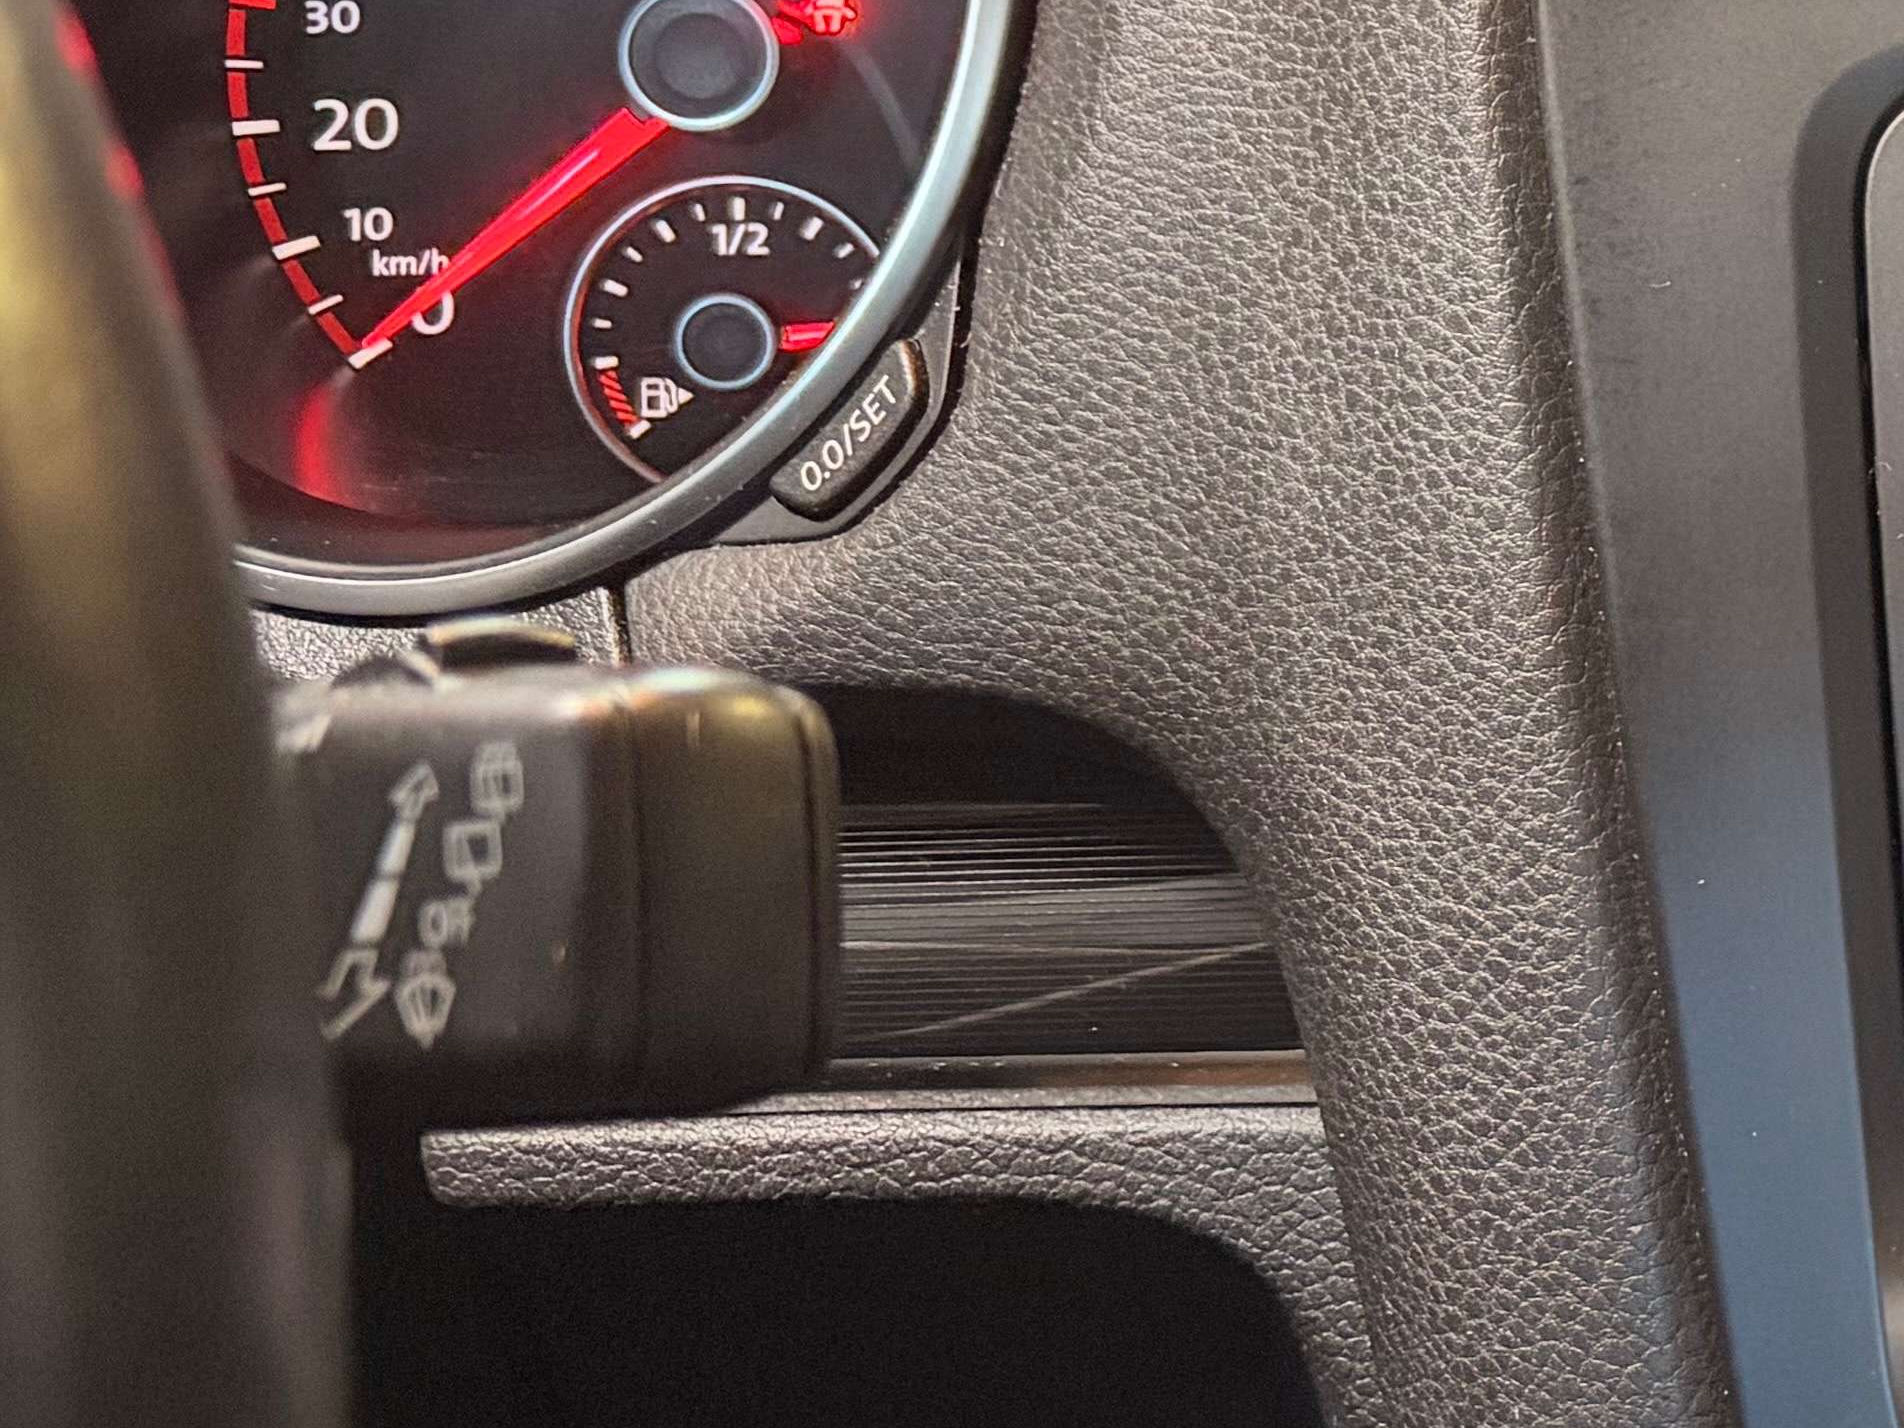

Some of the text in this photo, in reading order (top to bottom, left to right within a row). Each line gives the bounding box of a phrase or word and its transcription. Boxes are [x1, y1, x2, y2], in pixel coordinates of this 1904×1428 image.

[304, 0, 361, 34] 30
[312, 98, 399, 152] 20
[343, 207, 394, 242] 10
[711, 222, 769, 256] 1/2
[371, 247, 450, 276] km/h
[800, 374, 898, 492] 0.0/SET
